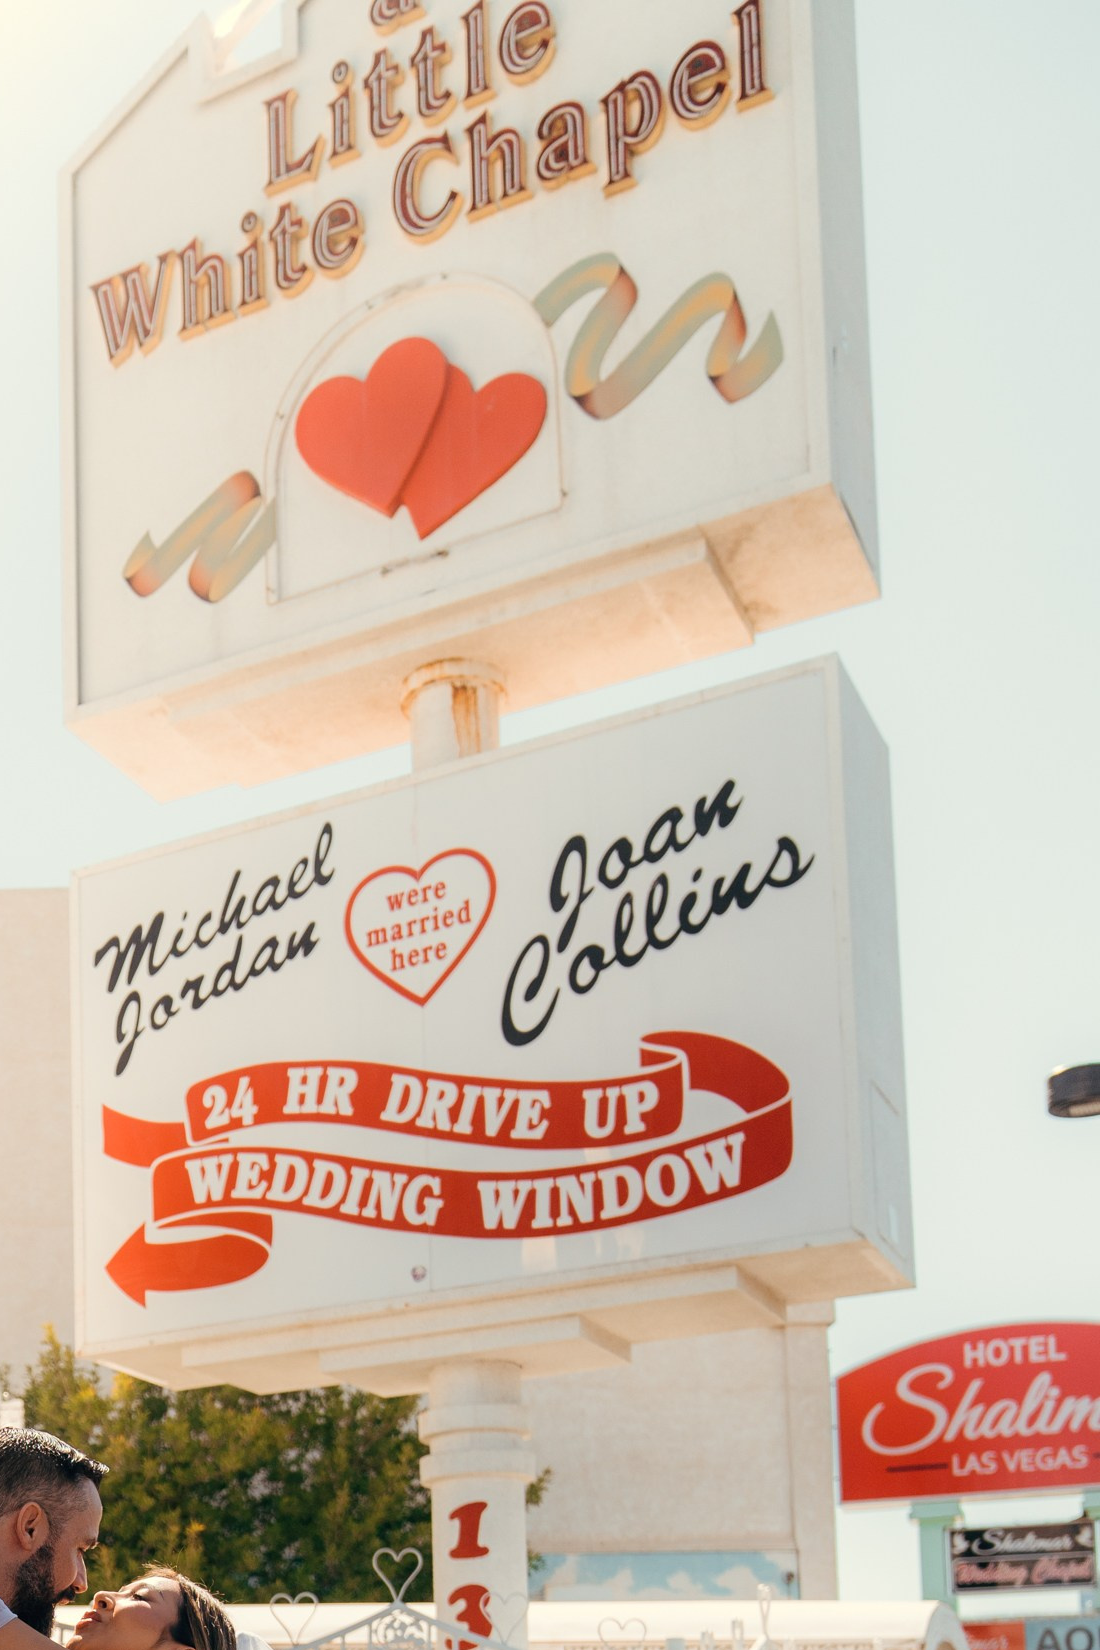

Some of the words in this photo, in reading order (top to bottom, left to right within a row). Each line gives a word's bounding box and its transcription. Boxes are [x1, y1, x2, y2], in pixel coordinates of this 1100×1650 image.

[264, 0, 555, 196] Little
[90, 198, 366, 367] White
[392, 0, 776, 243] Chapel
[94, 822, 336, 995] Michael
[387, 880, 447, 912] were
[549, 779, 744, 956] Joan
[366, 900, 472, 948] married
[390, 938, 448, 973] here
[500, 836, 816, 1047] Collins
[113, 921, 321, 1077] Jordan
[202, 1075, 259, 1126] 24
[282, 1066, 360, 1117] HR
[380, 1073, 551, 1140] DRIVE
[583, 1081, 660, 1139] UP
[185, 1153, 445, 1227] WEDDING
[477, 1132, 747, 1231] WINDOW
[963, 1335, 1067, 1368] HOTEL
[951, 1451, 996, 1477] LAS
[1002, 1444, 1090, 1472] VEGAS
